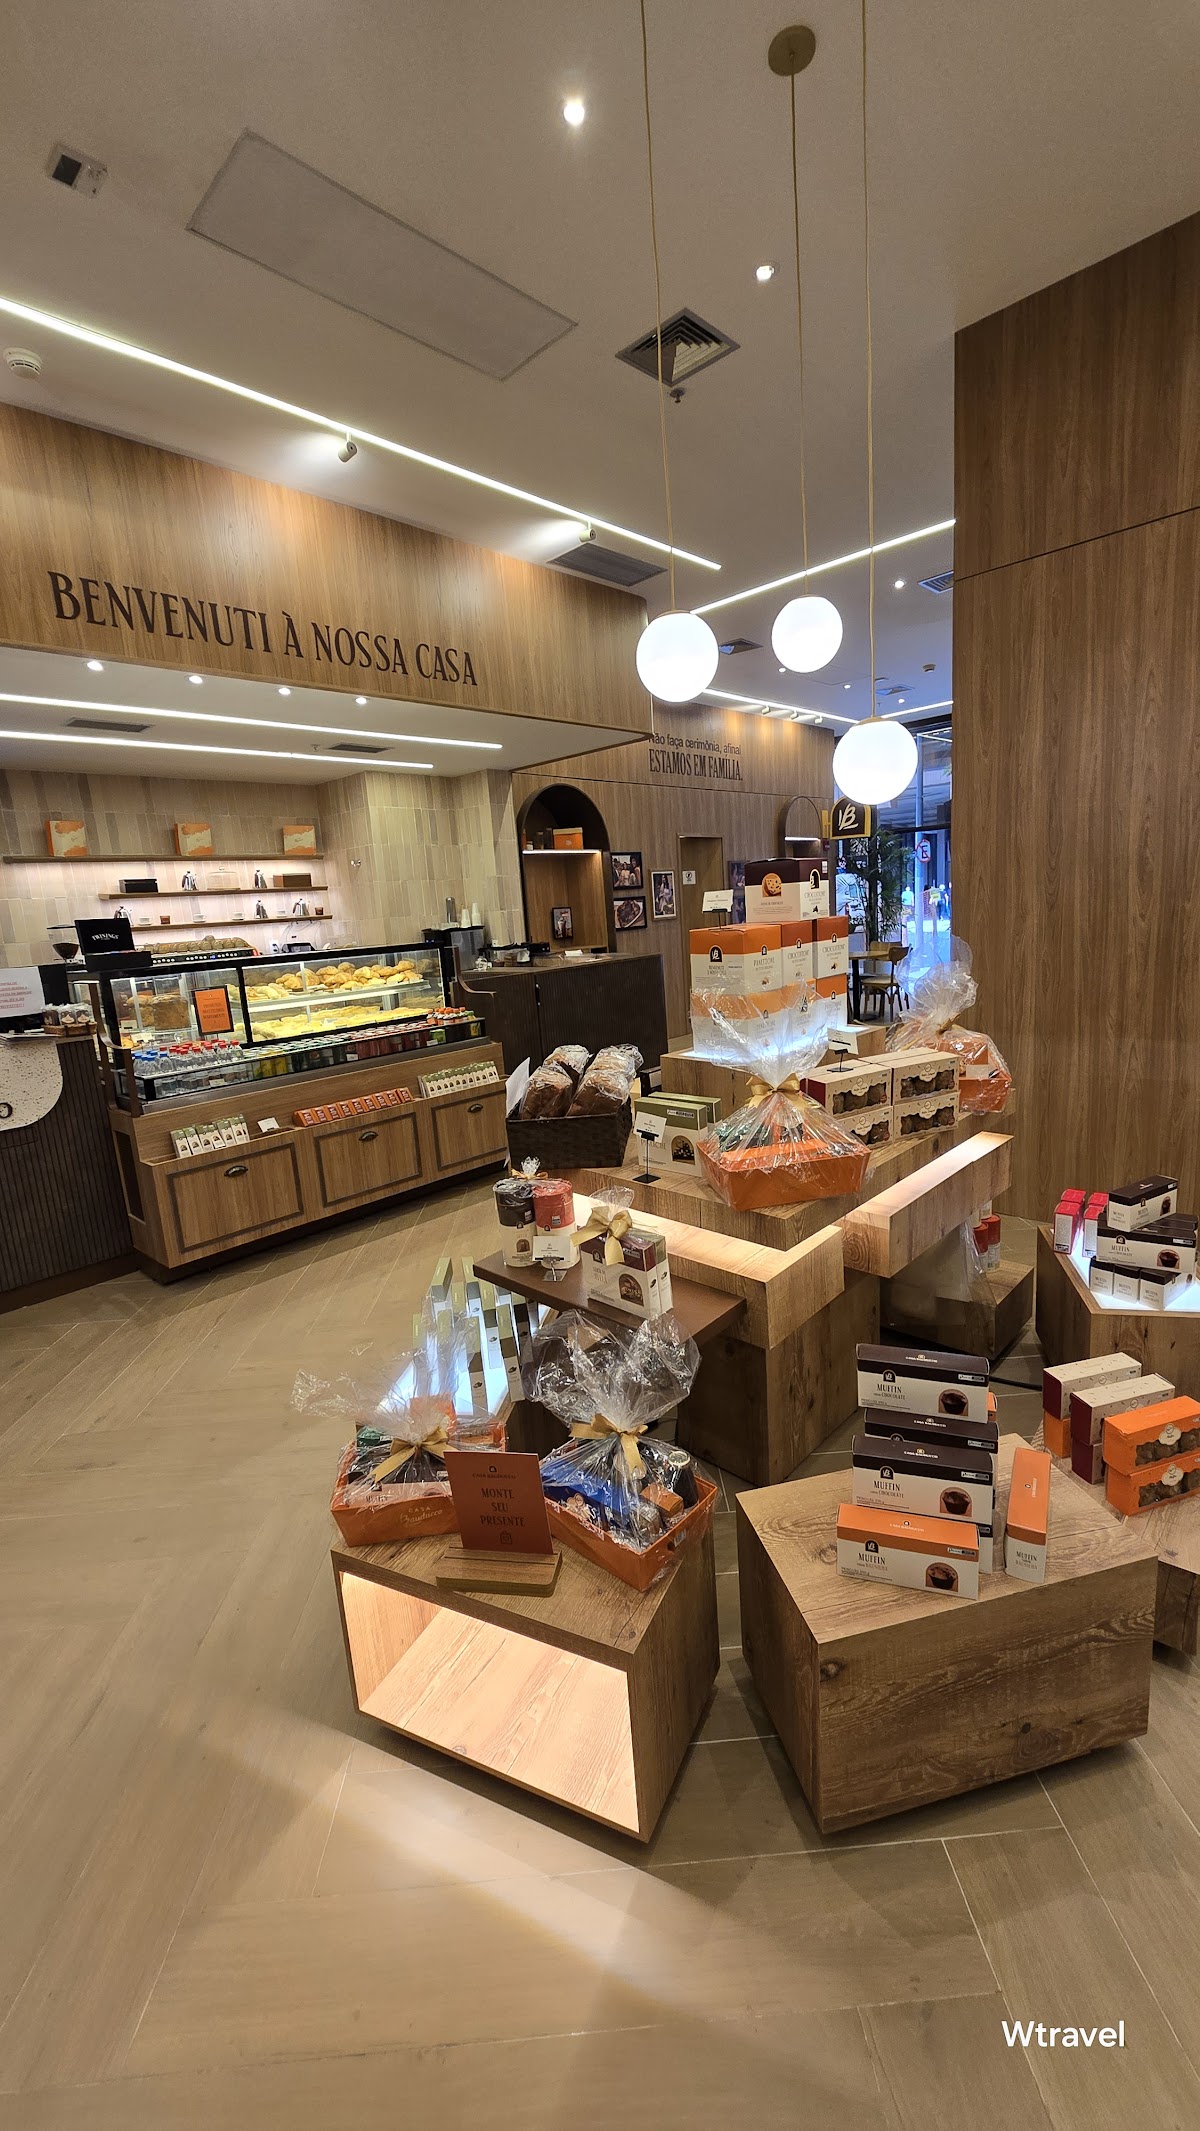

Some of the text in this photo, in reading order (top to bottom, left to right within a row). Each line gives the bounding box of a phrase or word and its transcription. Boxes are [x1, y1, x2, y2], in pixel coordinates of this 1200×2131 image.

[47, 570, 478, 686] BENVENUTI À NOSSA CASA
[667, 734, 684, 749] faça
[685, 738, 722, 754] cerimônia,
[723, 742, 742, 755] afinal
[648, 748, 744, 782] ESTAMOS EM FAMÍLIA.
[877, 1383, 902, 1394] MUFFIN
[873, 1480, 901, 1491] MUFFIN
[481, 1487, 516, 1500] MONTE
[879, 1490, 905, 1499] CHOCOLATE
[408, 1505, 432, 1514] CASA
[490, 1501, 509, 1513] SEU
[479, 1514, 526, 1527] PRESENTE
[858, 1552, 886, 1565] MUFFIN
[1016, 1550, 1038, 1561] MUFFIN
